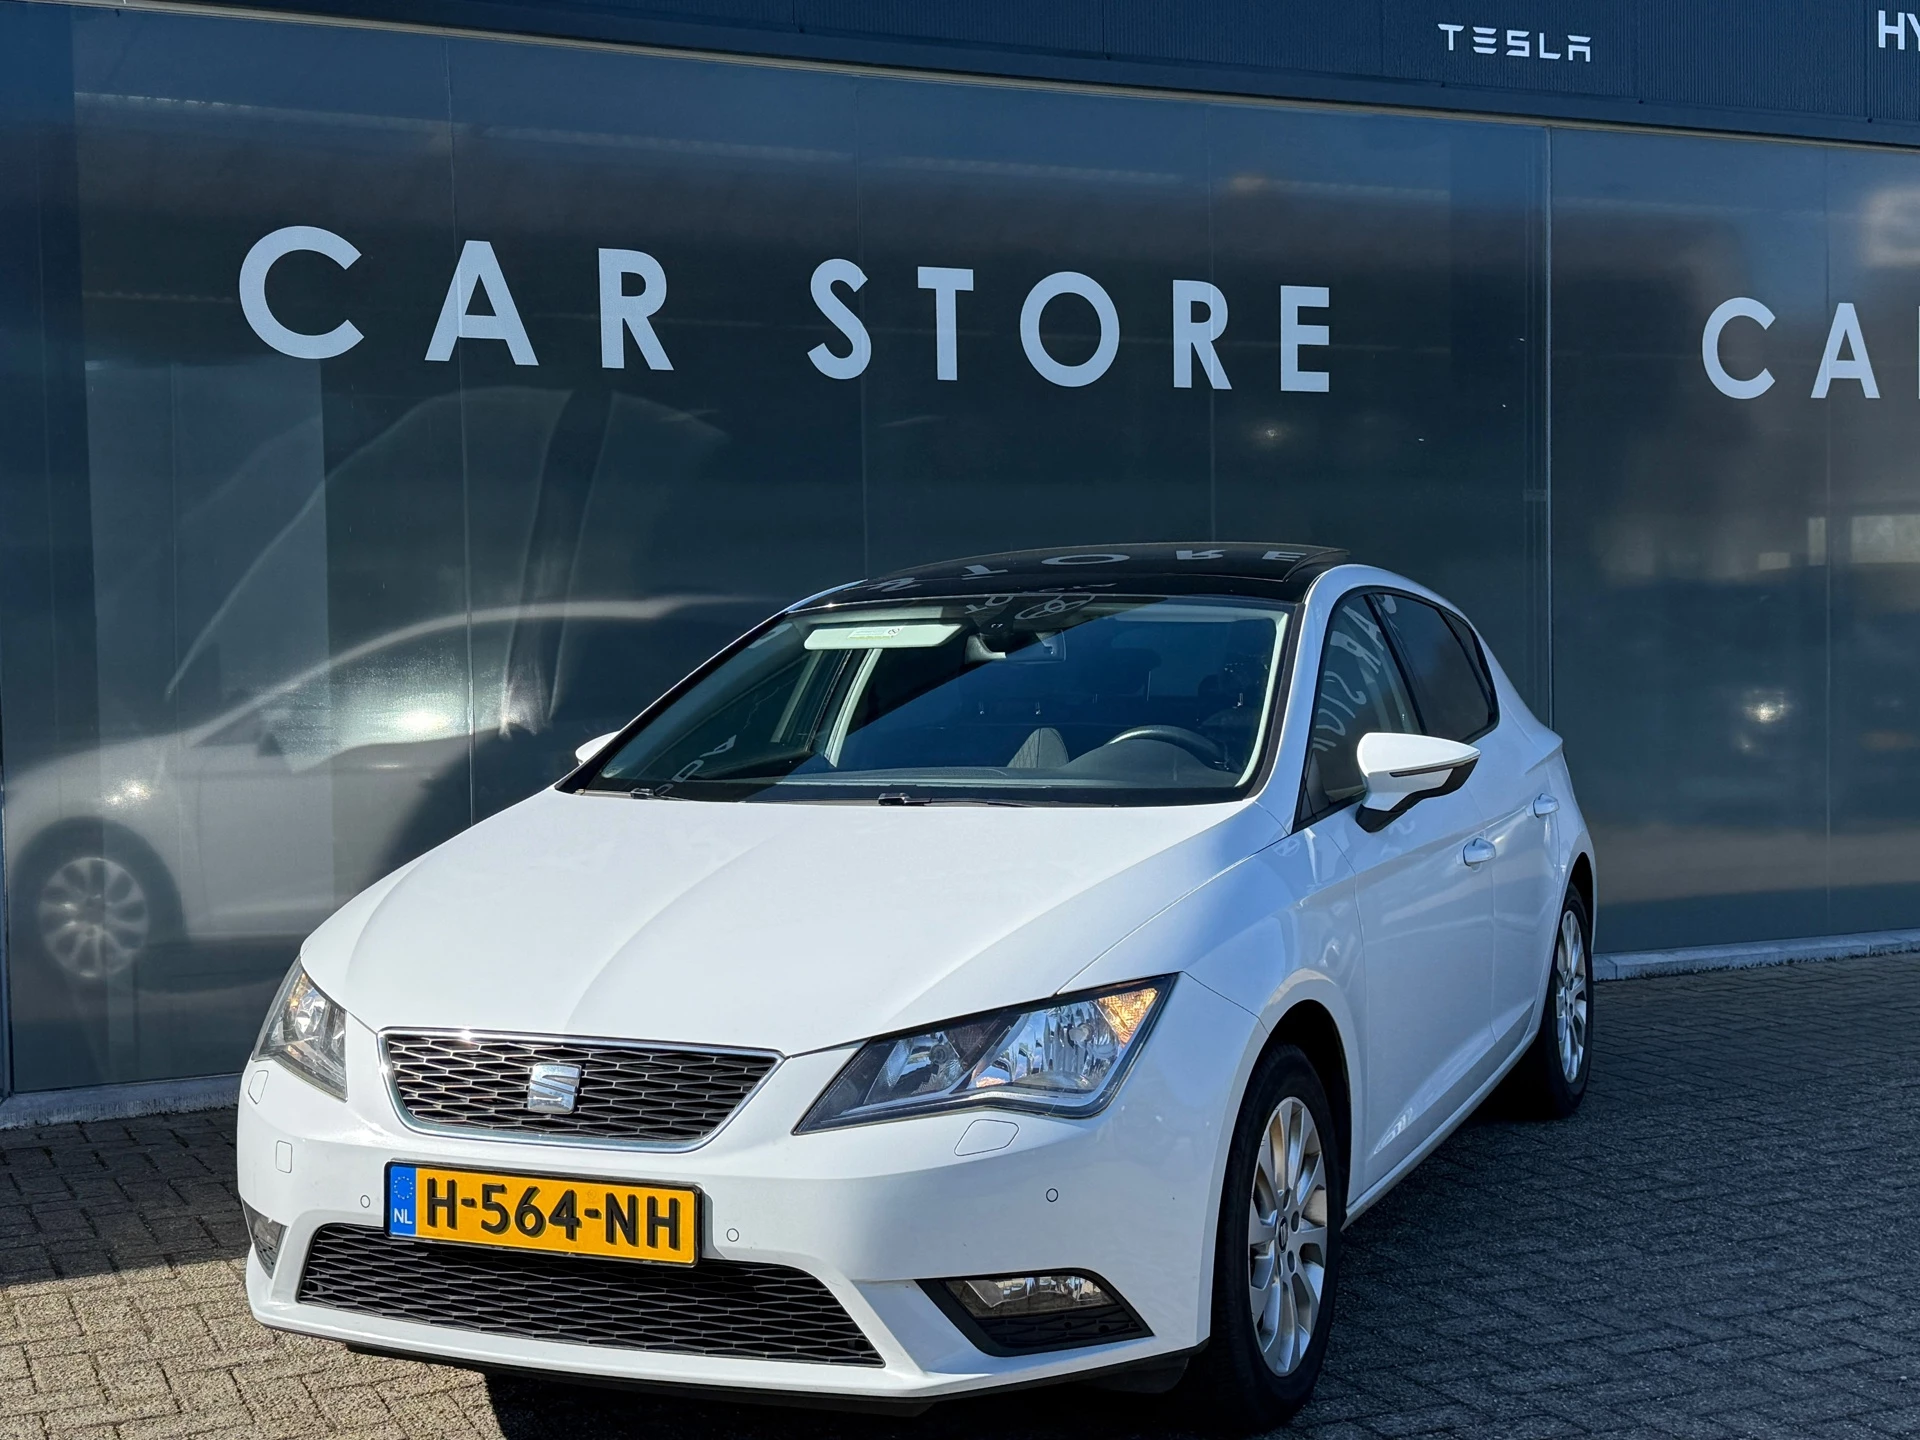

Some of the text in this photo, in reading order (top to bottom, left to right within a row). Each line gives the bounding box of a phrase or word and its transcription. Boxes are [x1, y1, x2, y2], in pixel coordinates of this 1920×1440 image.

[1438, 24, 1591, 62] TESLA
[239, 226, 1330, 392] CAR STORE
[1702, 297, 1920, 400] CA
[393, 1177, 681, 1251] NL H-564-NH
